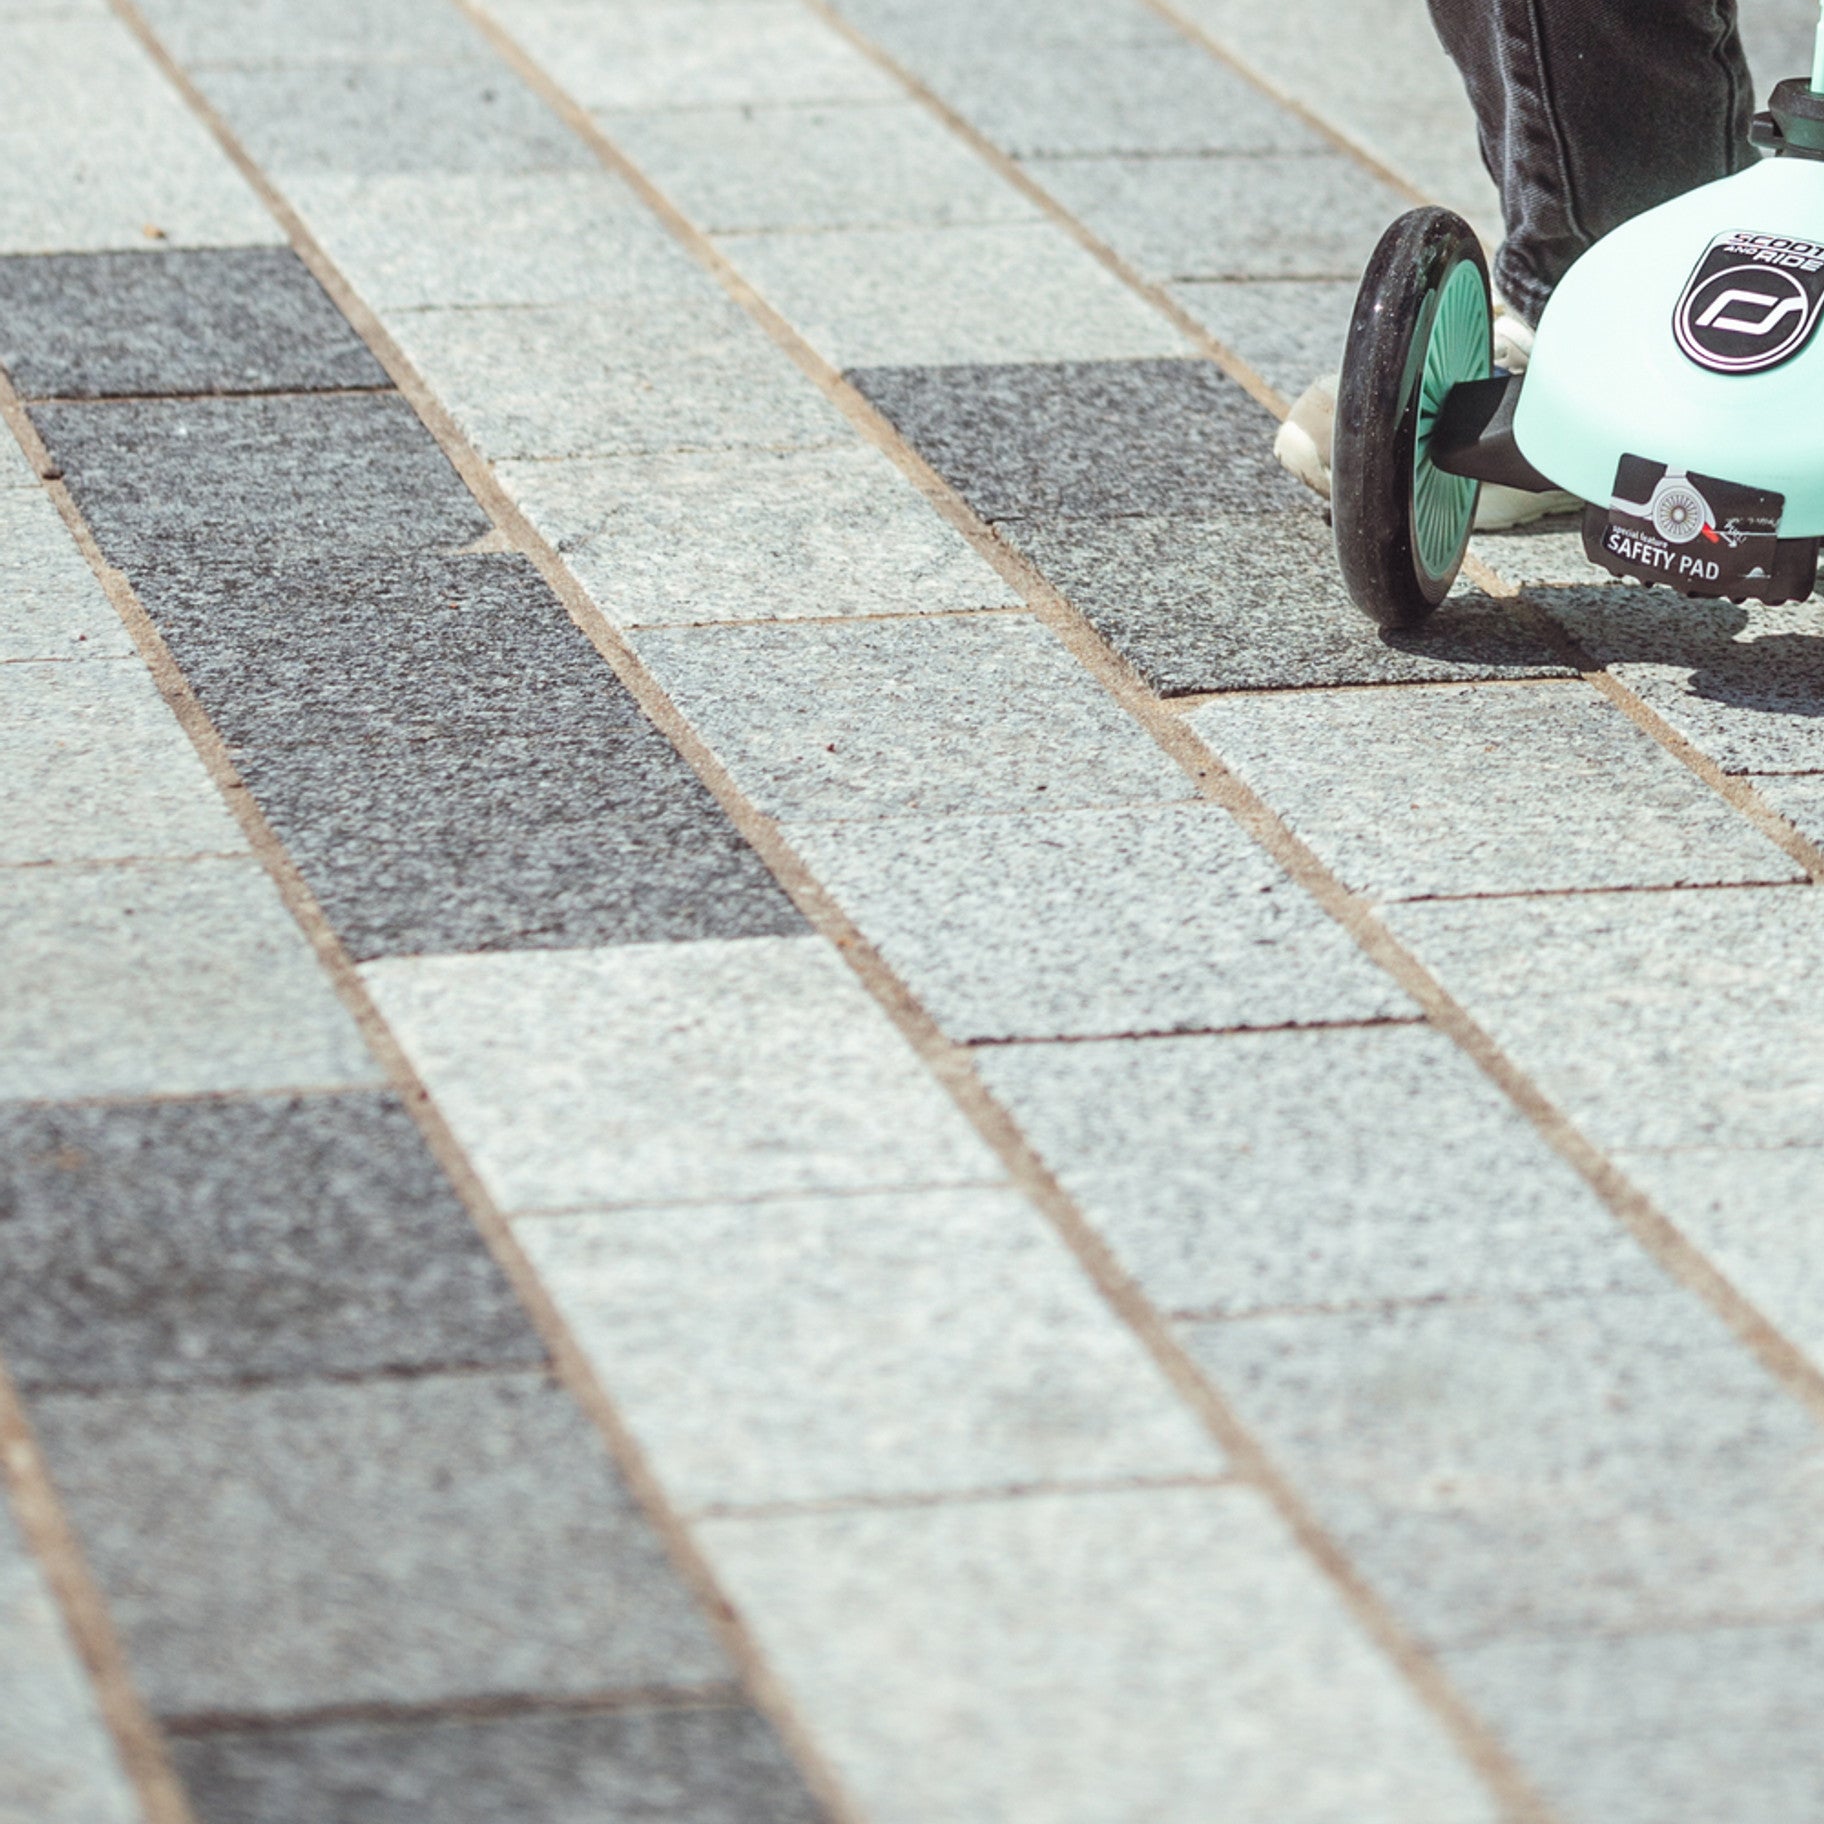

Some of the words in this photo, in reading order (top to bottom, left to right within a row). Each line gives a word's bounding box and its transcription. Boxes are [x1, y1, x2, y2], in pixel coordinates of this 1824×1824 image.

[1753, 250, 1824, 272] RIDE
[1607, 533, 1676, 571] SAFETY
[1679, 554, 1720, 580] PAD
